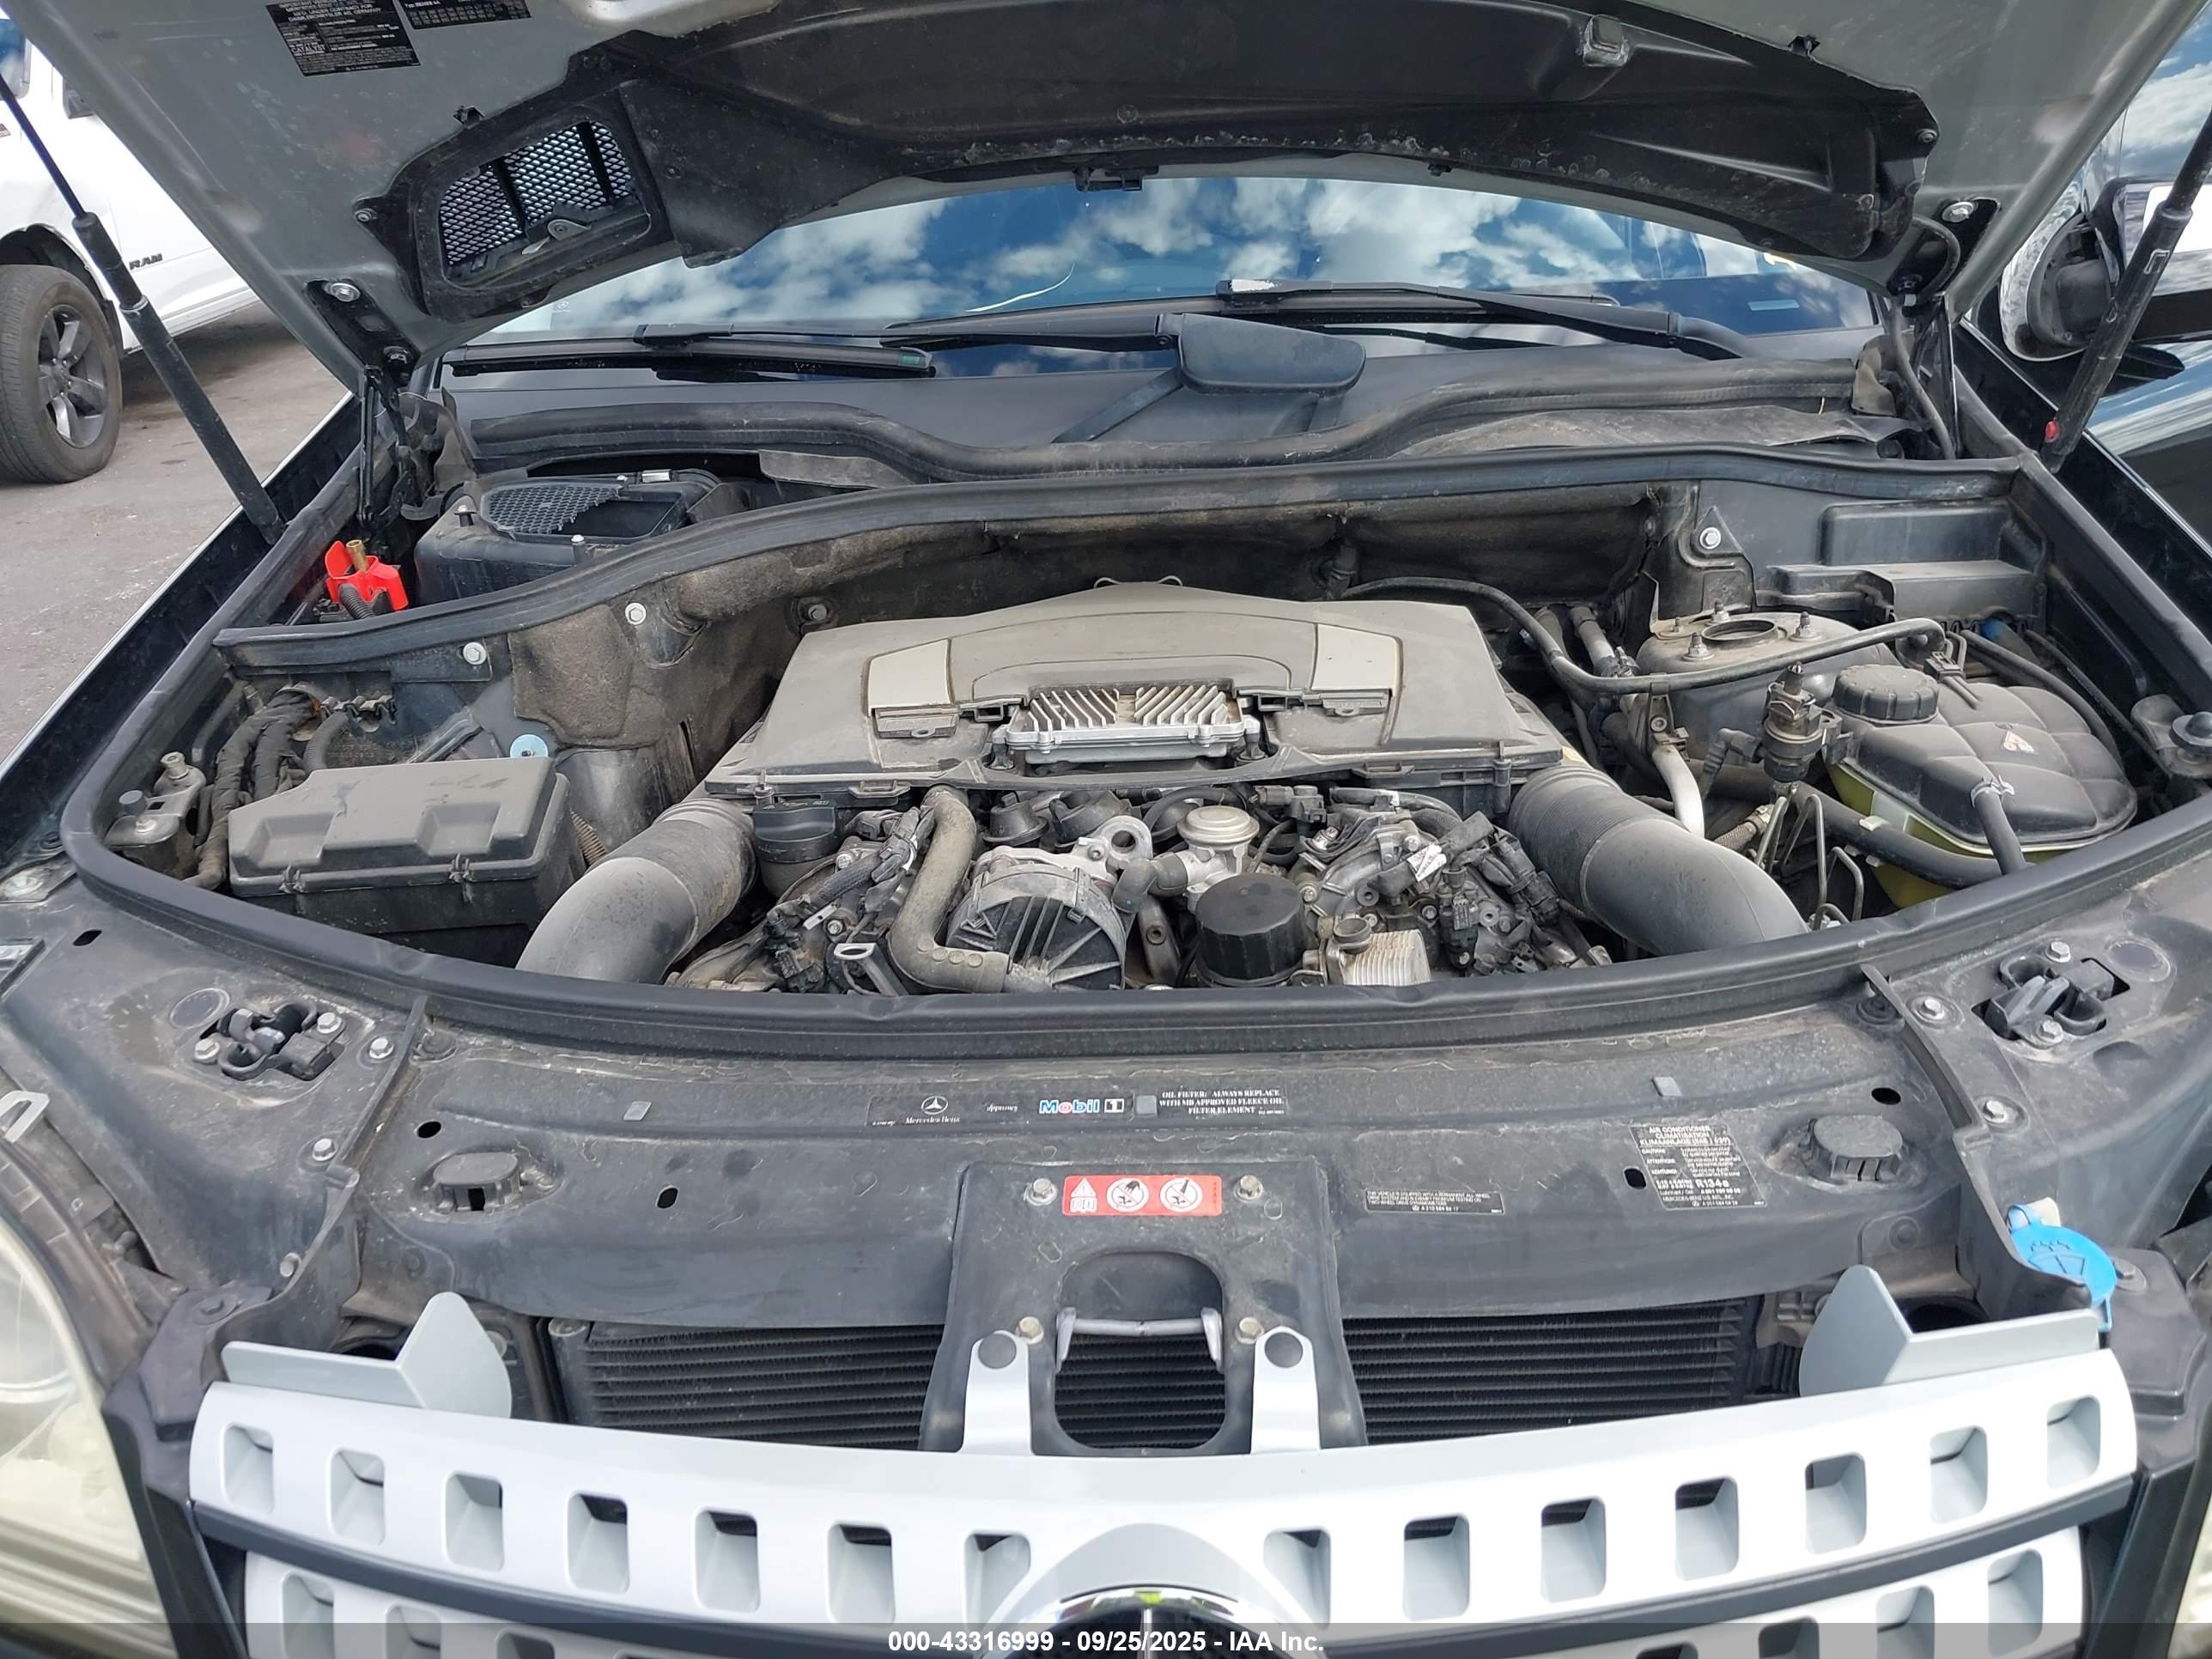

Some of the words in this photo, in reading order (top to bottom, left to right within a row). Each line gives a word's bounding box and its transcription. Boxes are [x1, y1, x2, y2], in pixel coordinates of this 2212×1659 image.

[129, 253, 163, 270] RAM
[1039, 1099, 1100, 1114] Mobil
[1695, 1178, 1729, 1188] R134a
